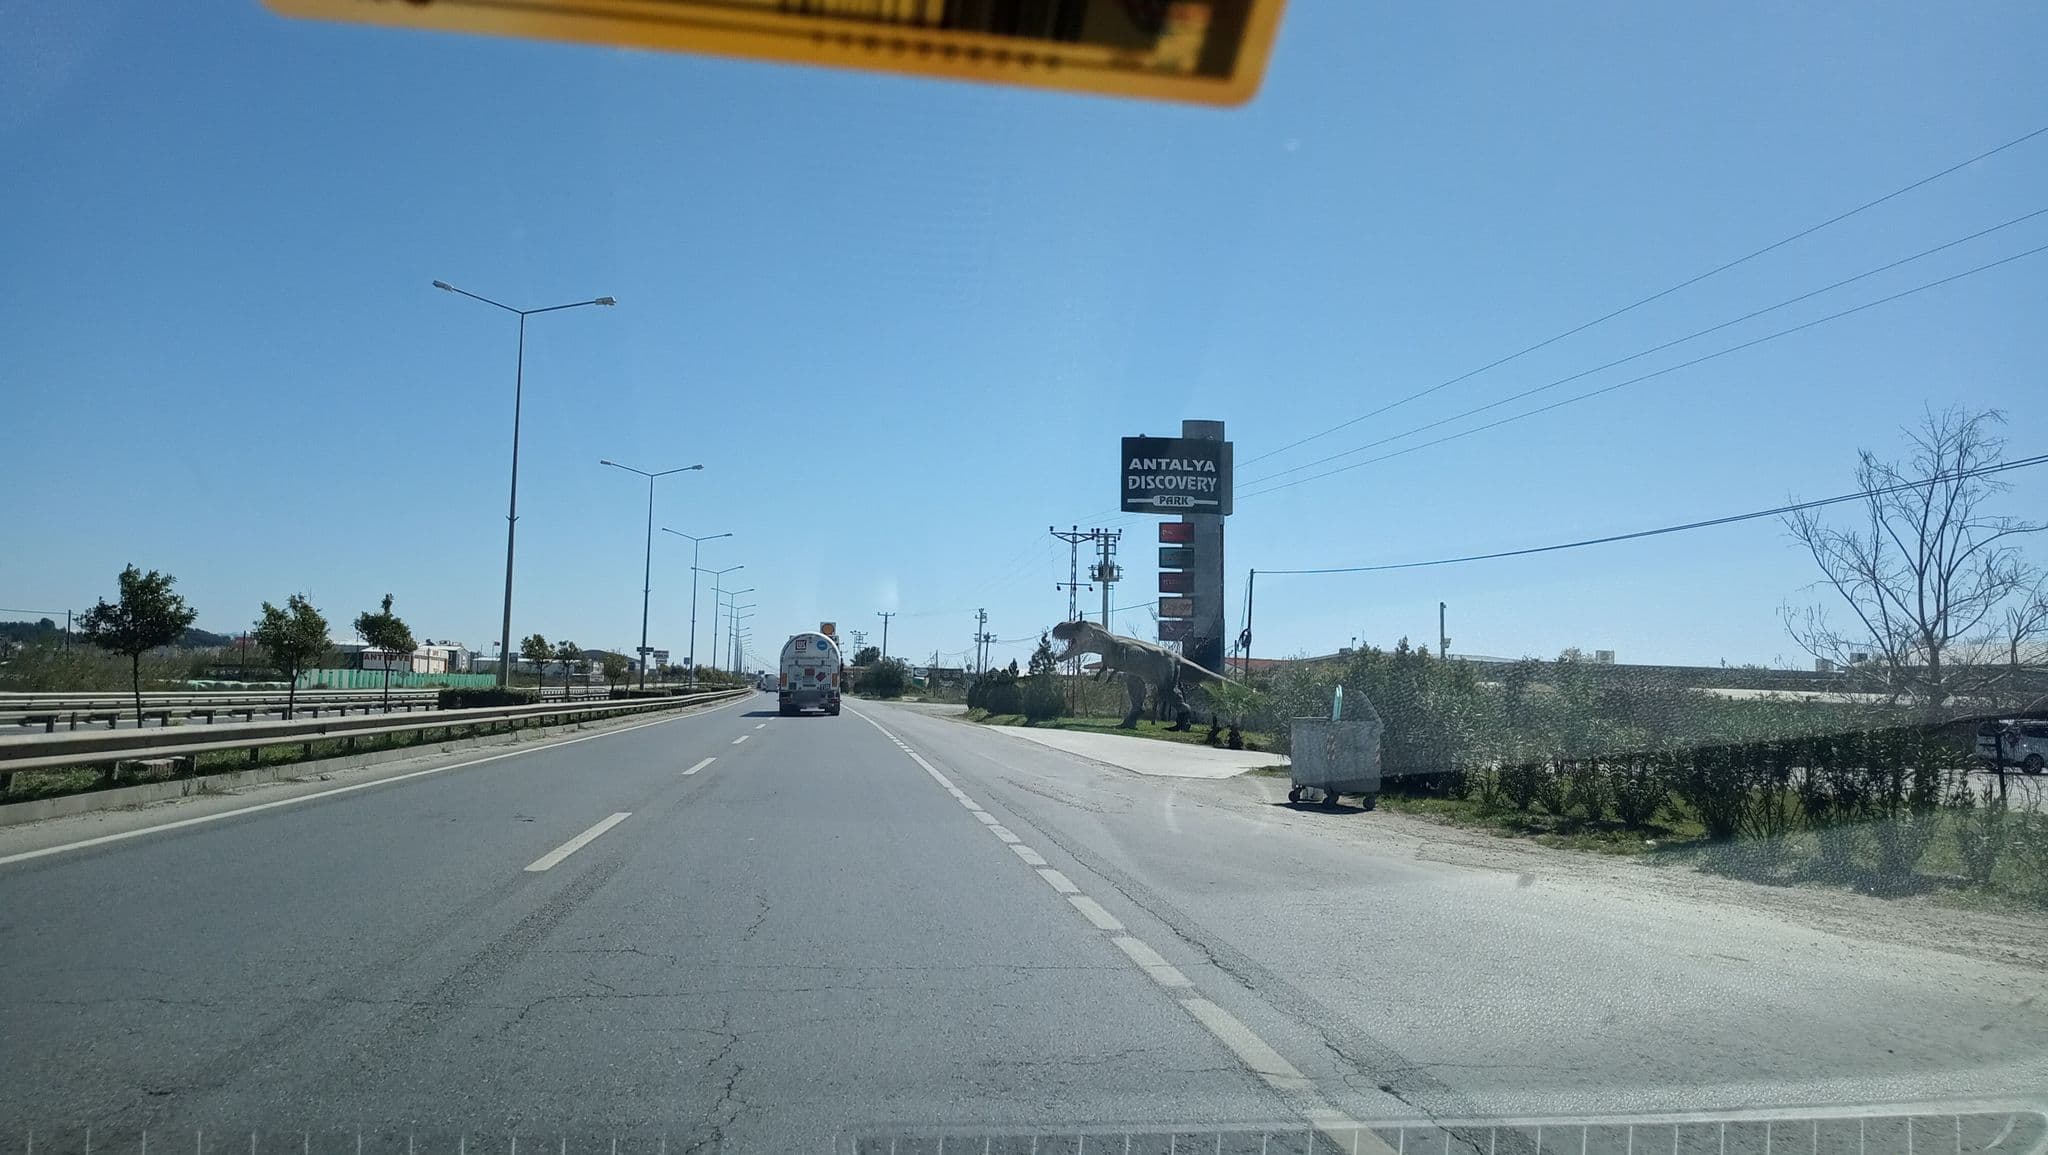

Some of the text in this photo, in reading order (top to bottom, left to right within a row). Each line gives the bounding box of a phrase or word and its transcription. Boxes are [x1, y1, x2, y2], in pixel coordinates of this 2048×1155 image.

[1128, 458, 1216, 472] ANTALYA
[1128, 475, 1217, 492] DISCOVERY
[1159, 496, 1189, 505] PARK
